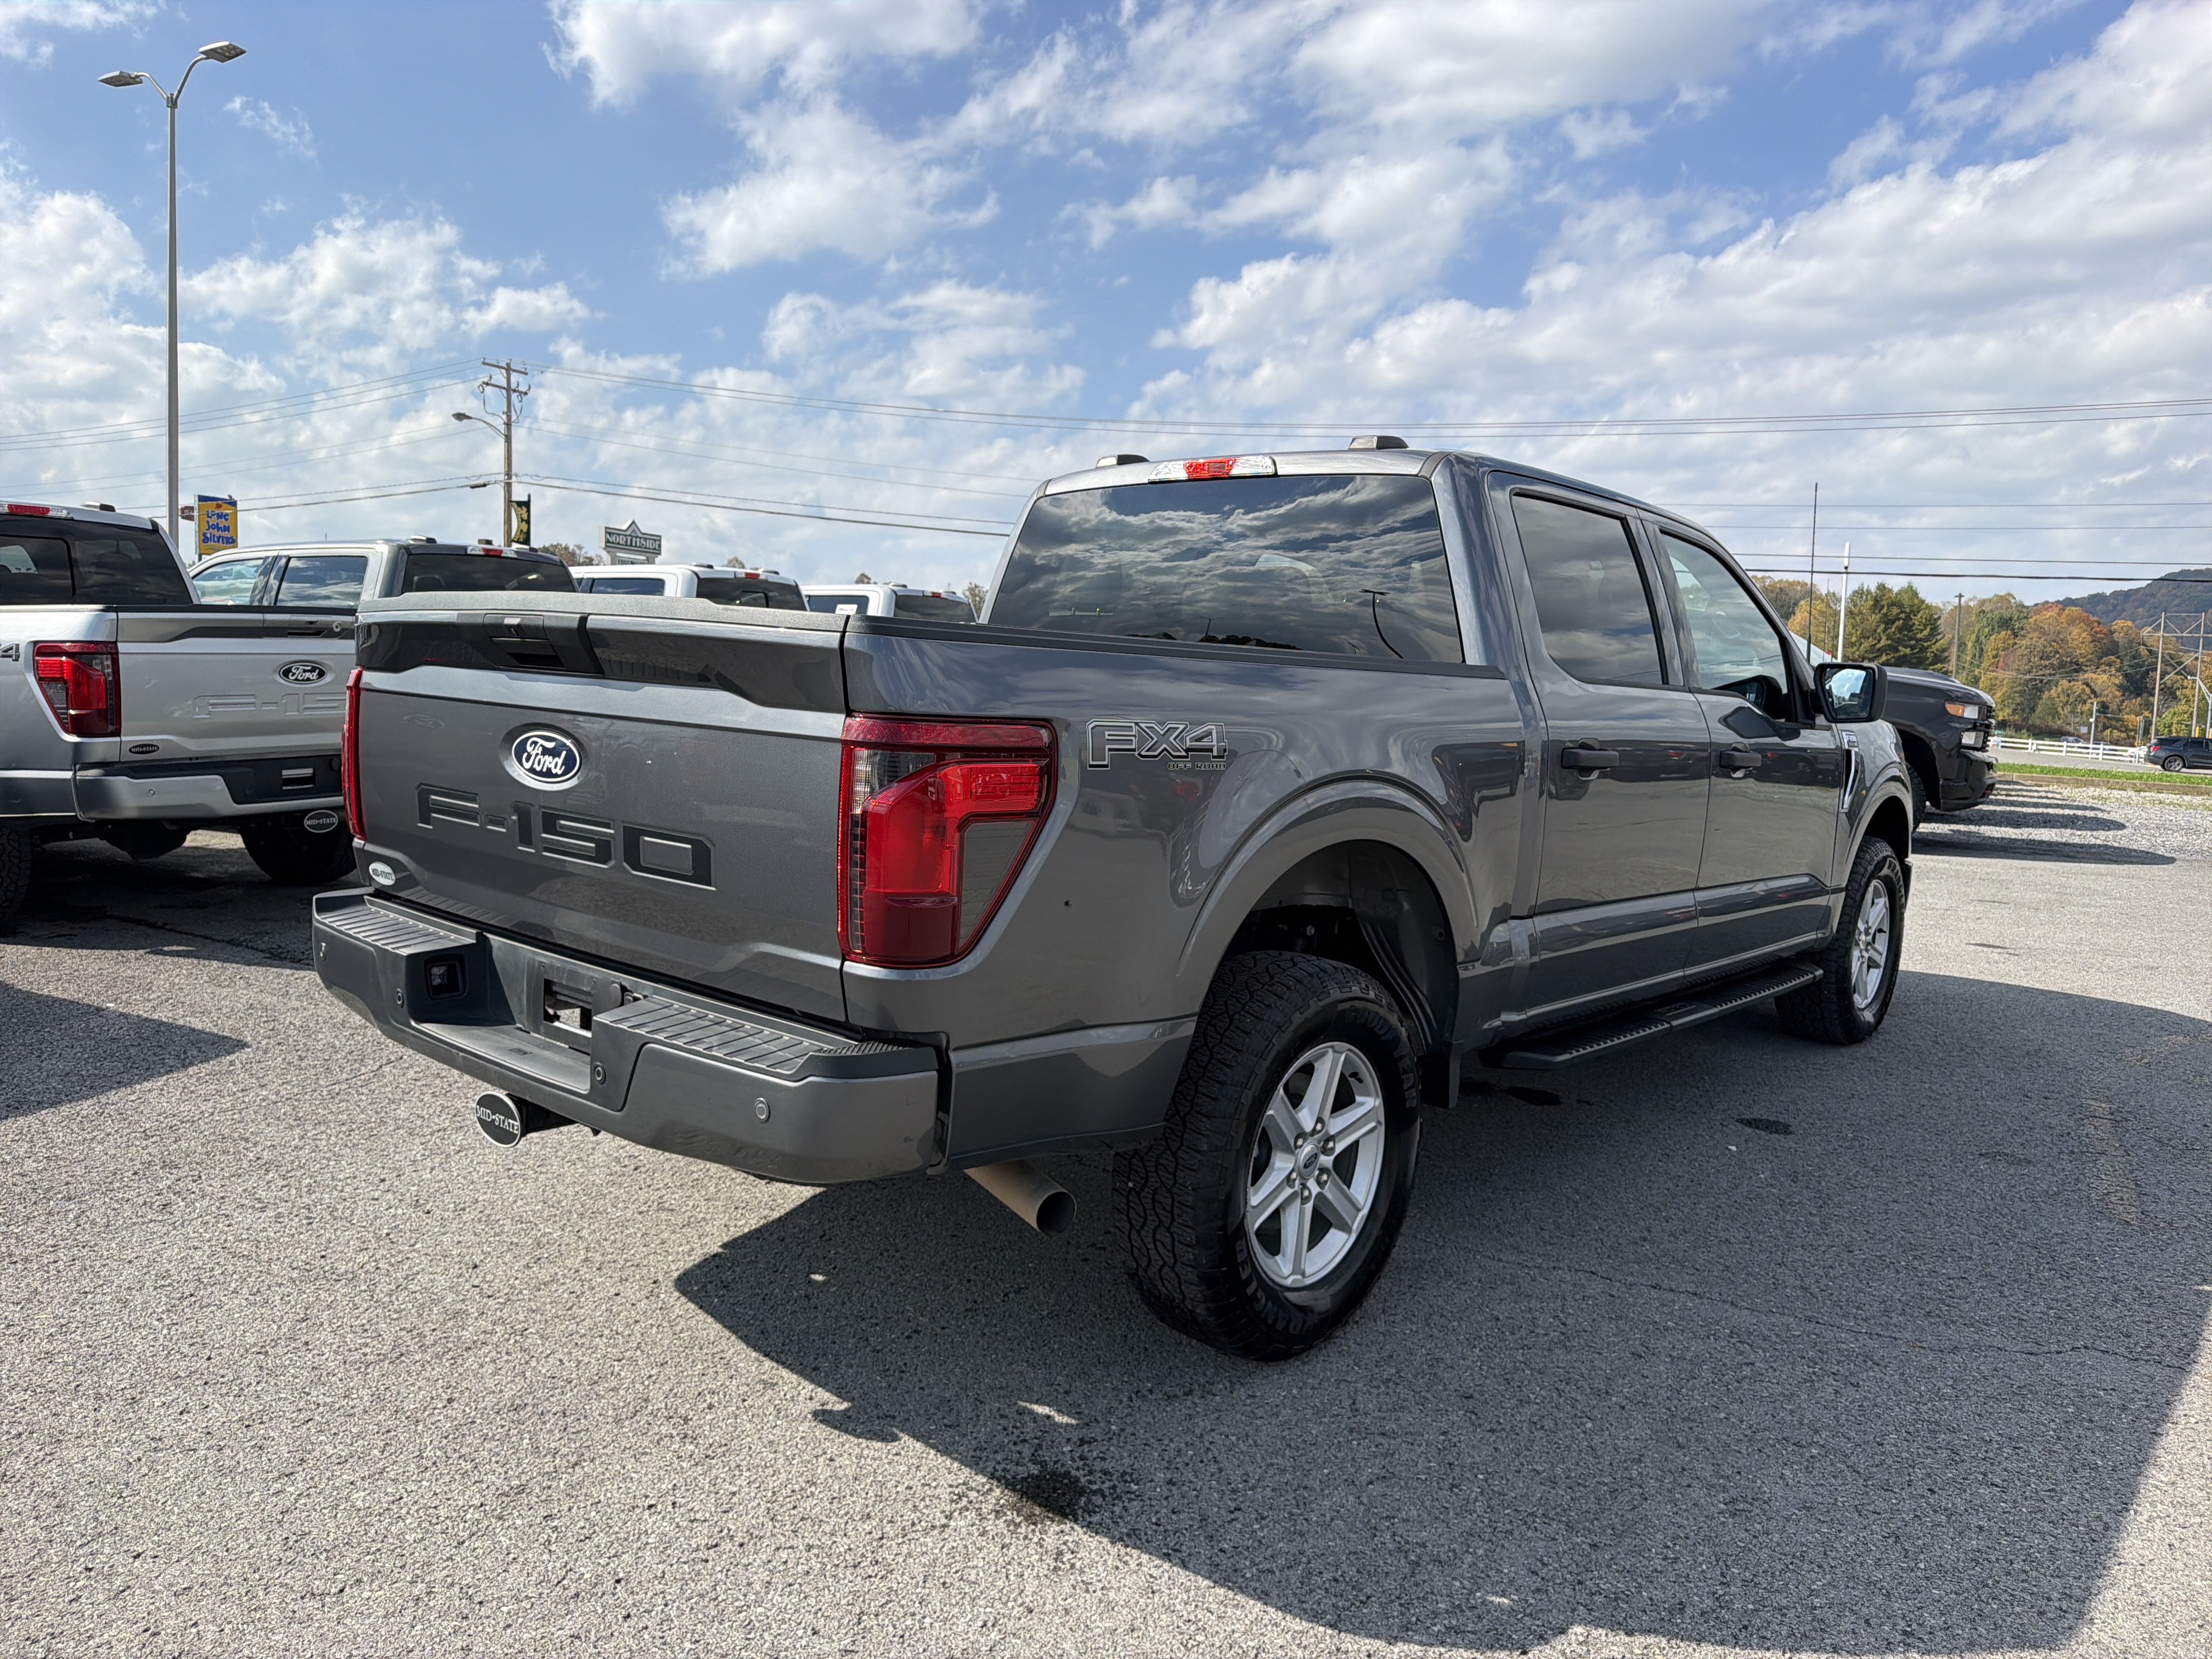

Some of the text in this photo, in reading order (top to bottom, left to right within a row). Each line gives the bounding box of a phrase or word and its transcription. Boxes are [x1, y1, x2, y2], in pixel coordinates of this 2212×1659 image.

[606, 533, 661, 550] NORTHSIDE
[289, 665, 319, 680] Ford
[522, 737, 567, 775] Ford
[1086, 719, 1228, 770] FX4
[1167, 762, 1227, 770] OFF ROAD
[306, 816, 336, 825] MID-STATE
[417, 782, 716, 890] F-150
[476, 1104, 518, 1134] MID-STATE
